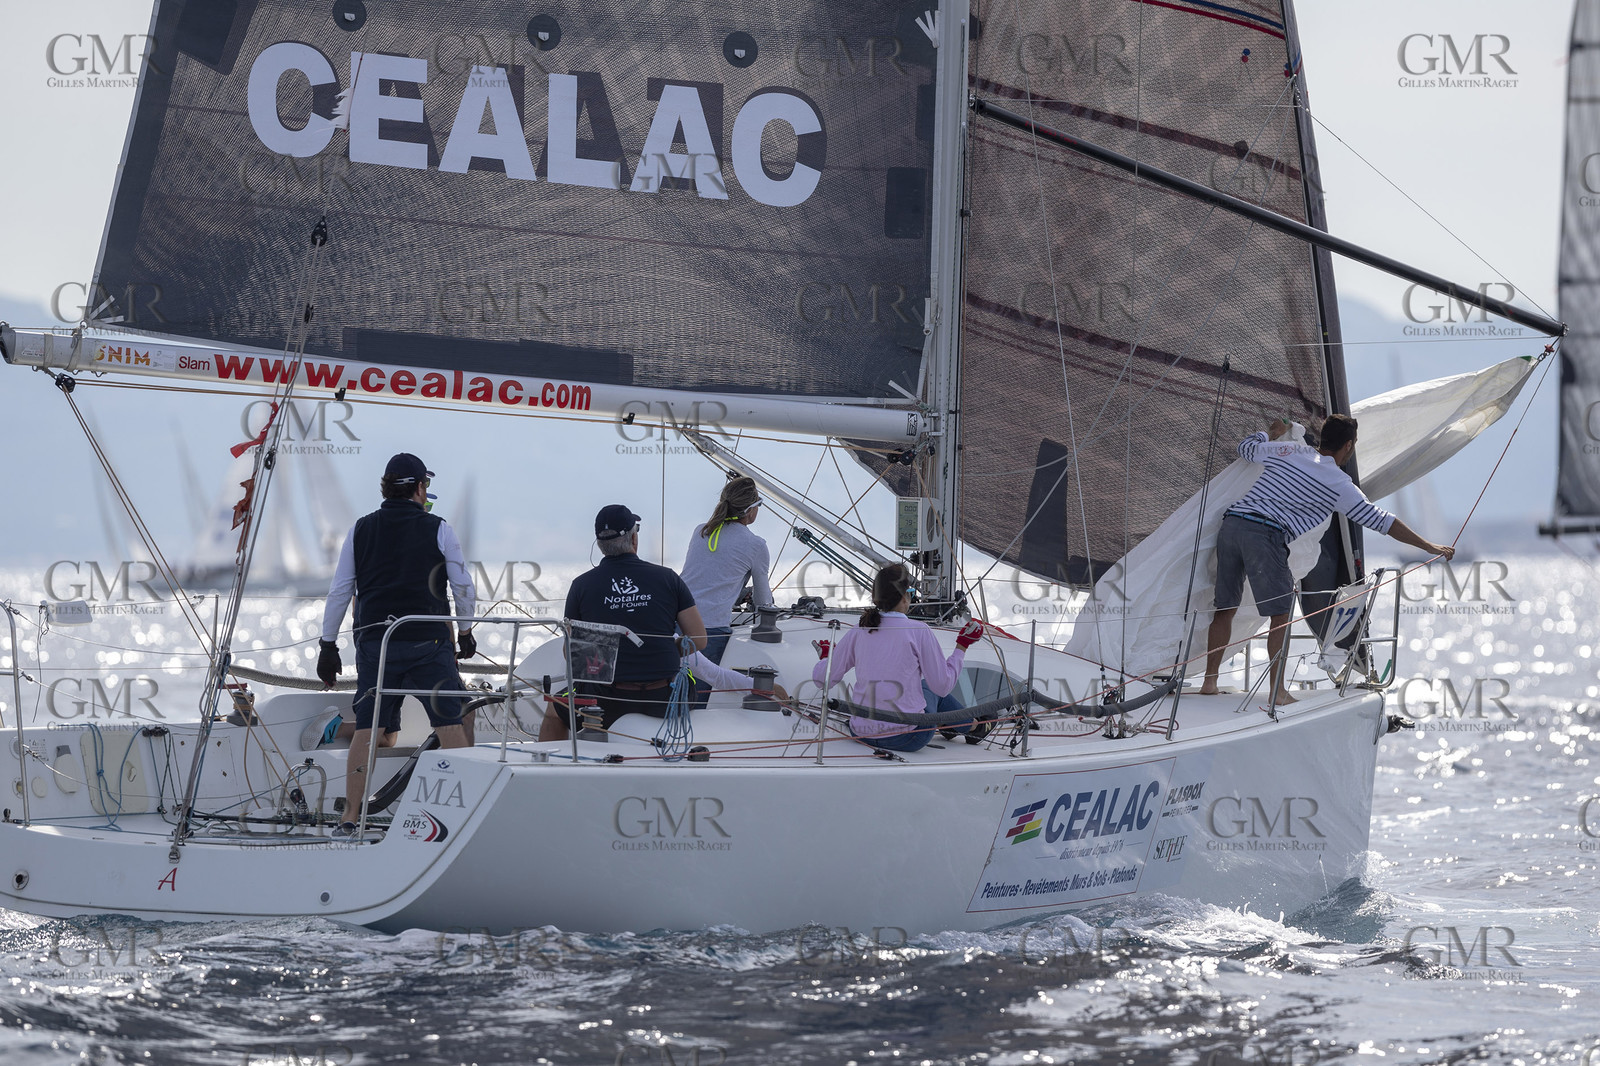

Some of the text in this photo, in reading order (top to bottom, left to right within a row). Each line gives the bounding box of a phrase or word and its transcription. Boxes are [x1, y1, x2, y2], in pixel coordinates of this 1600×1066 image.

[247, 42, 822, 207] CEALAC
[178, 356, 210, 371] Slam
[214, 353, 592, 411] www.cealac.com
[604, 593, 652, 604] Notaires
[412, 775, 466, 808] MA
[403, 820, 427, 829] BMS
[1045, 781, 1159, 843] CEALAC
[158, 867, 177, 891] A
[981, 882, 1020, 899] Peintures
[1069, 873, 1088, 890] Murs
[1093, 869, 1107, 887] Sols
[1109, 864, 1138, 884] Plafonds
